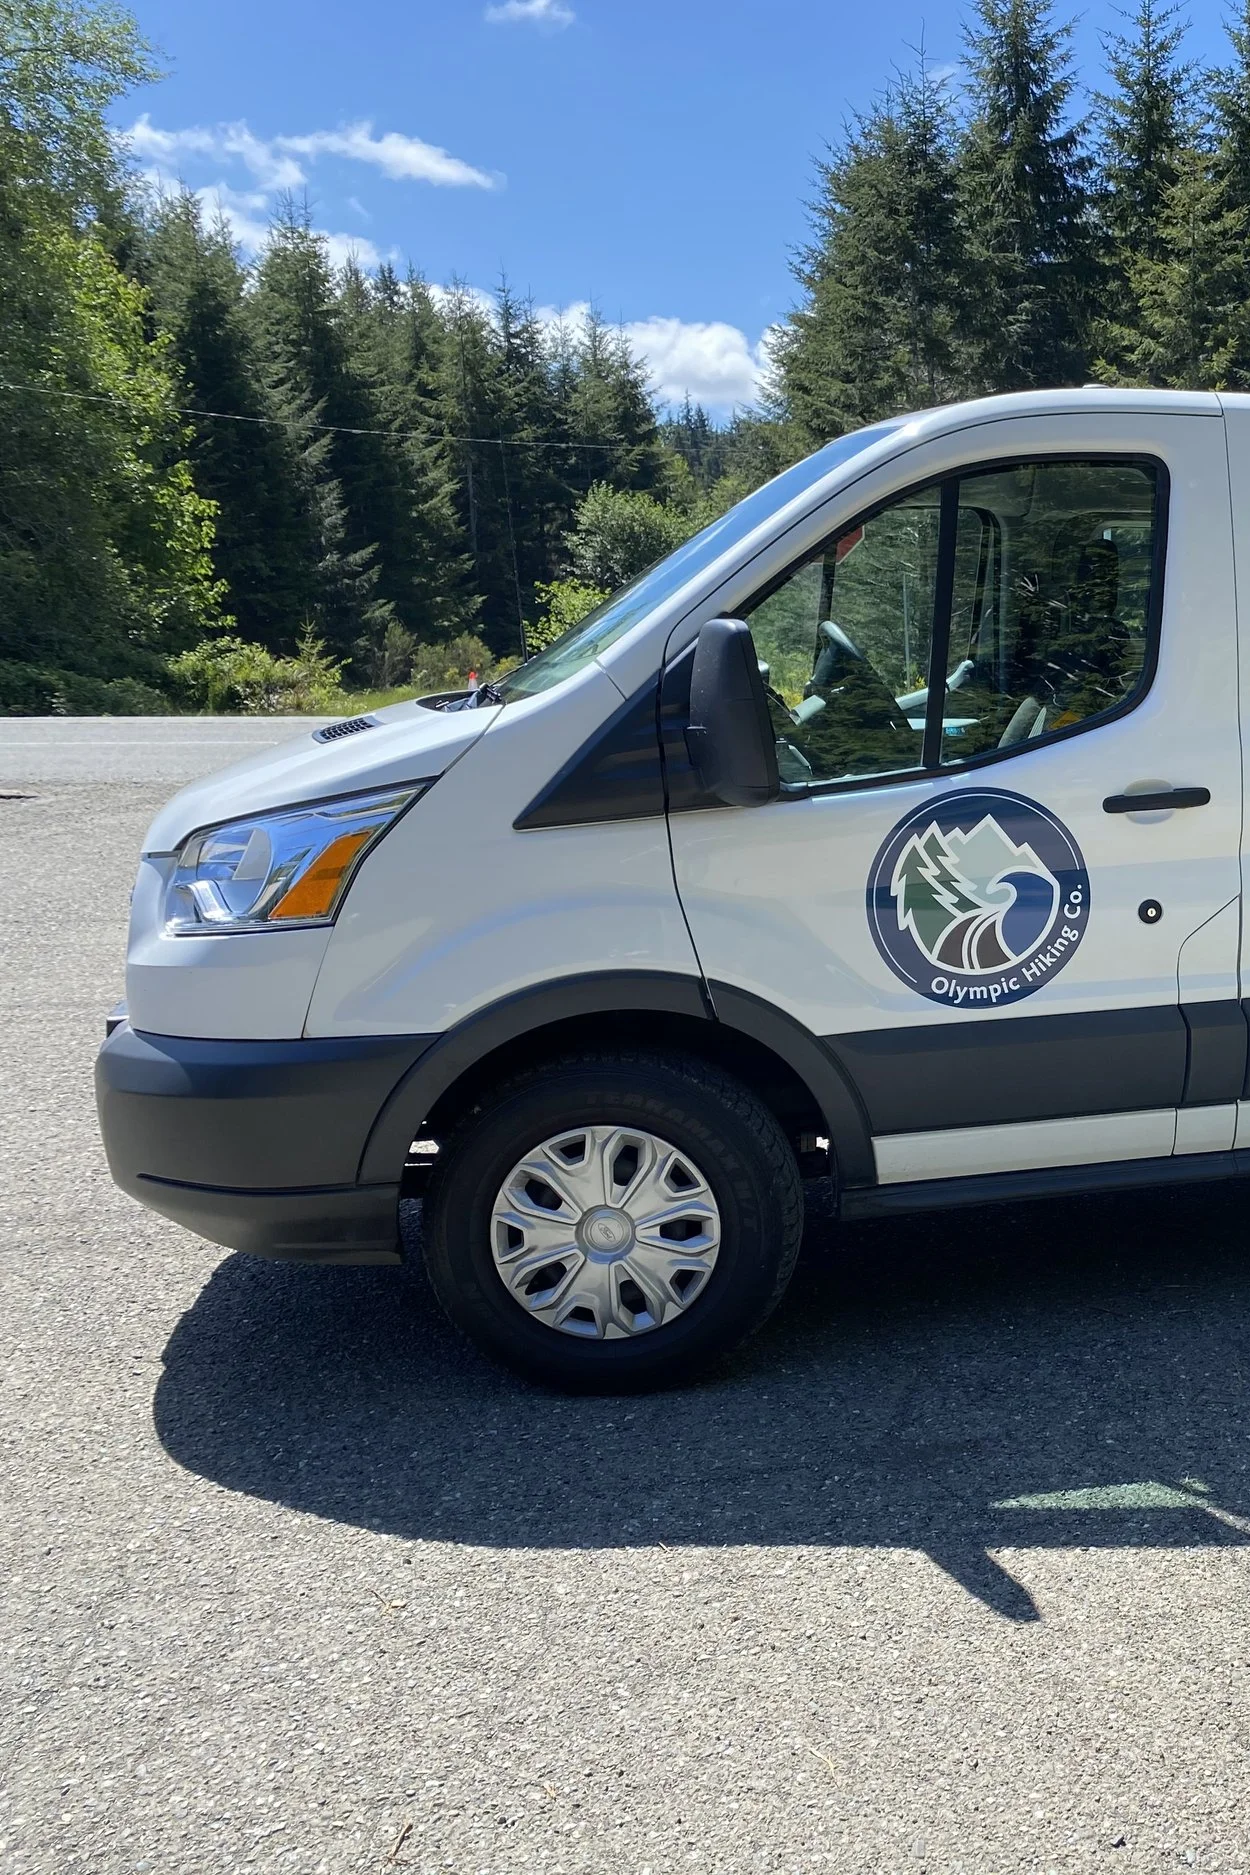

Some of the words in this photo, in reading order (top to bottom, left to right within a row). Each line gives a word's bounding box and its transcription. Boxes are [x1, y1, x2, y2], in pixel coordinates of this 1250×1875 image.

[931, 976, 1021, 1004] Olympic
[1021, 924, 1079, 983] Hiking
[1063, 883, 1083, 919] Co.
